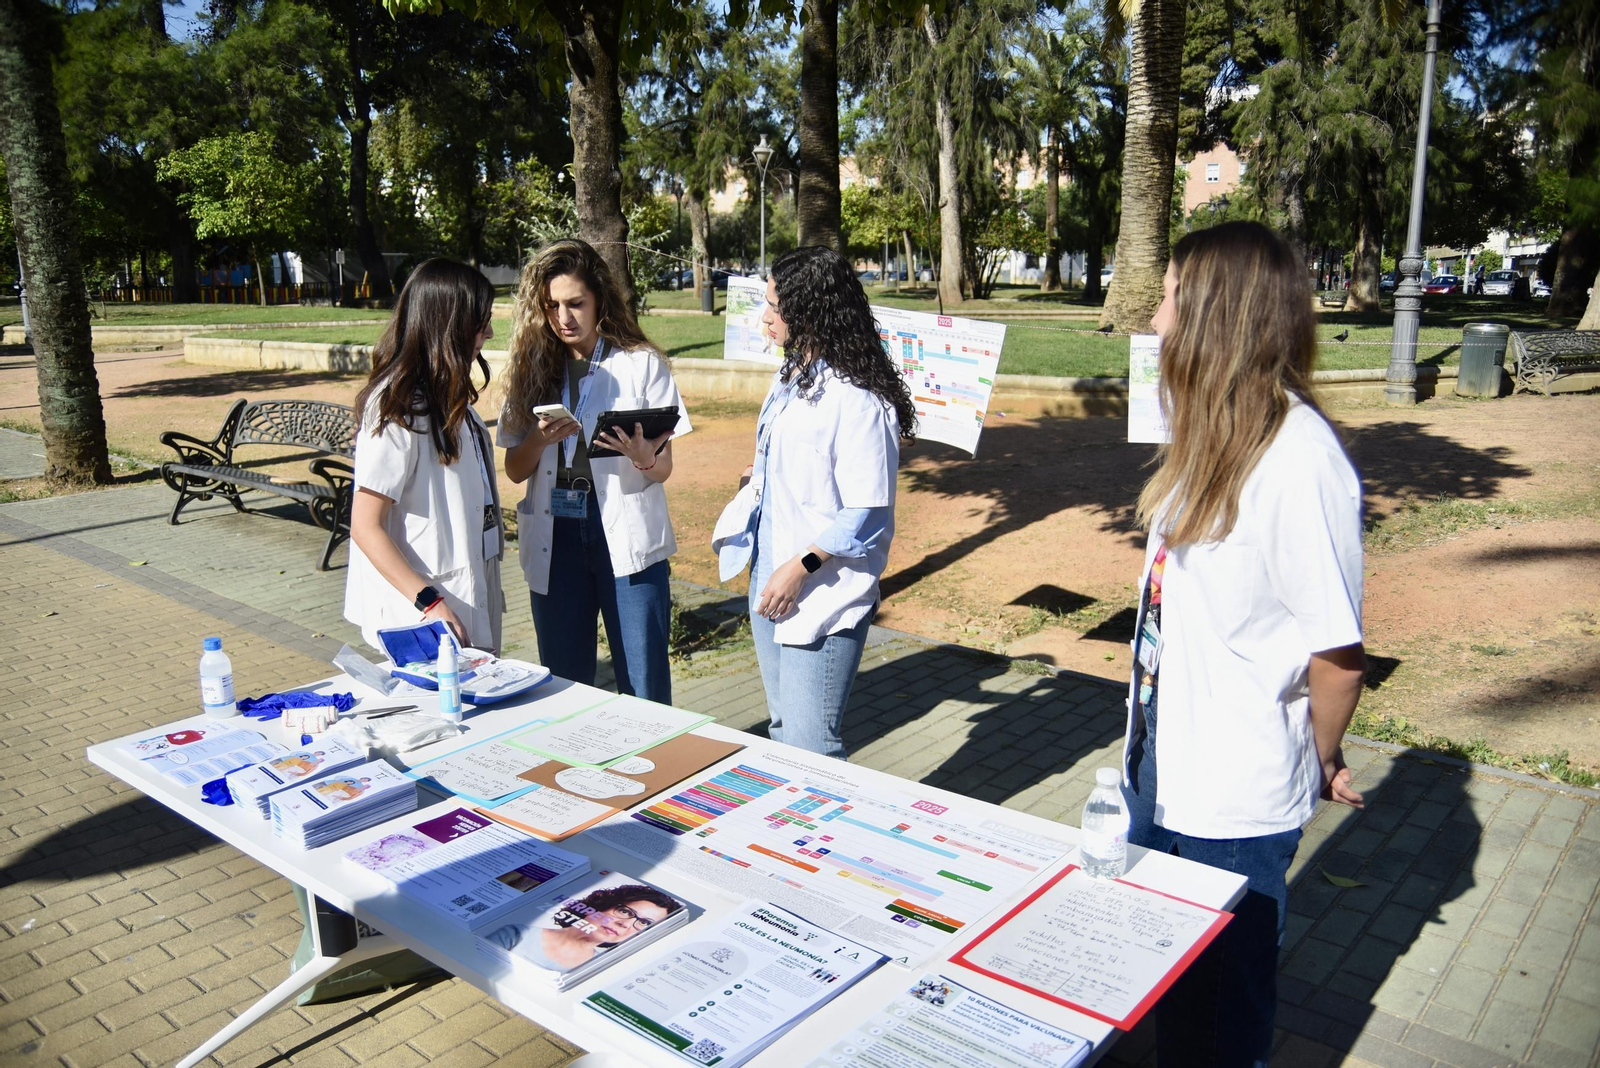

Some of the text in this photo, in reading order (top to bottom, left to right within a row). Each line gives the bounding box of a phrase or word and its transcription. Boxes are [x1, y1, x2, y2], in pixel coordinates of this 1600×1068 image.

[938, 317, 952, 327] 2025
[912, 800, 947, 814] 2025
[555, 893, 616, 926] HERPES
[755, 907, 797, 930] #Paremos
[751, 912, 799, 936] laNeumonía
[734, 922, 828, 964] ¿QUÉ ES LA NEUMONÍA?
[1029, 930, 1064, 946] adultos
[972, 999, 1010, 1016] RAZONES
[1007, 1014, 1031, 1025] PARA
[1027, 1023, 1075, 1044] VACUNARSE
